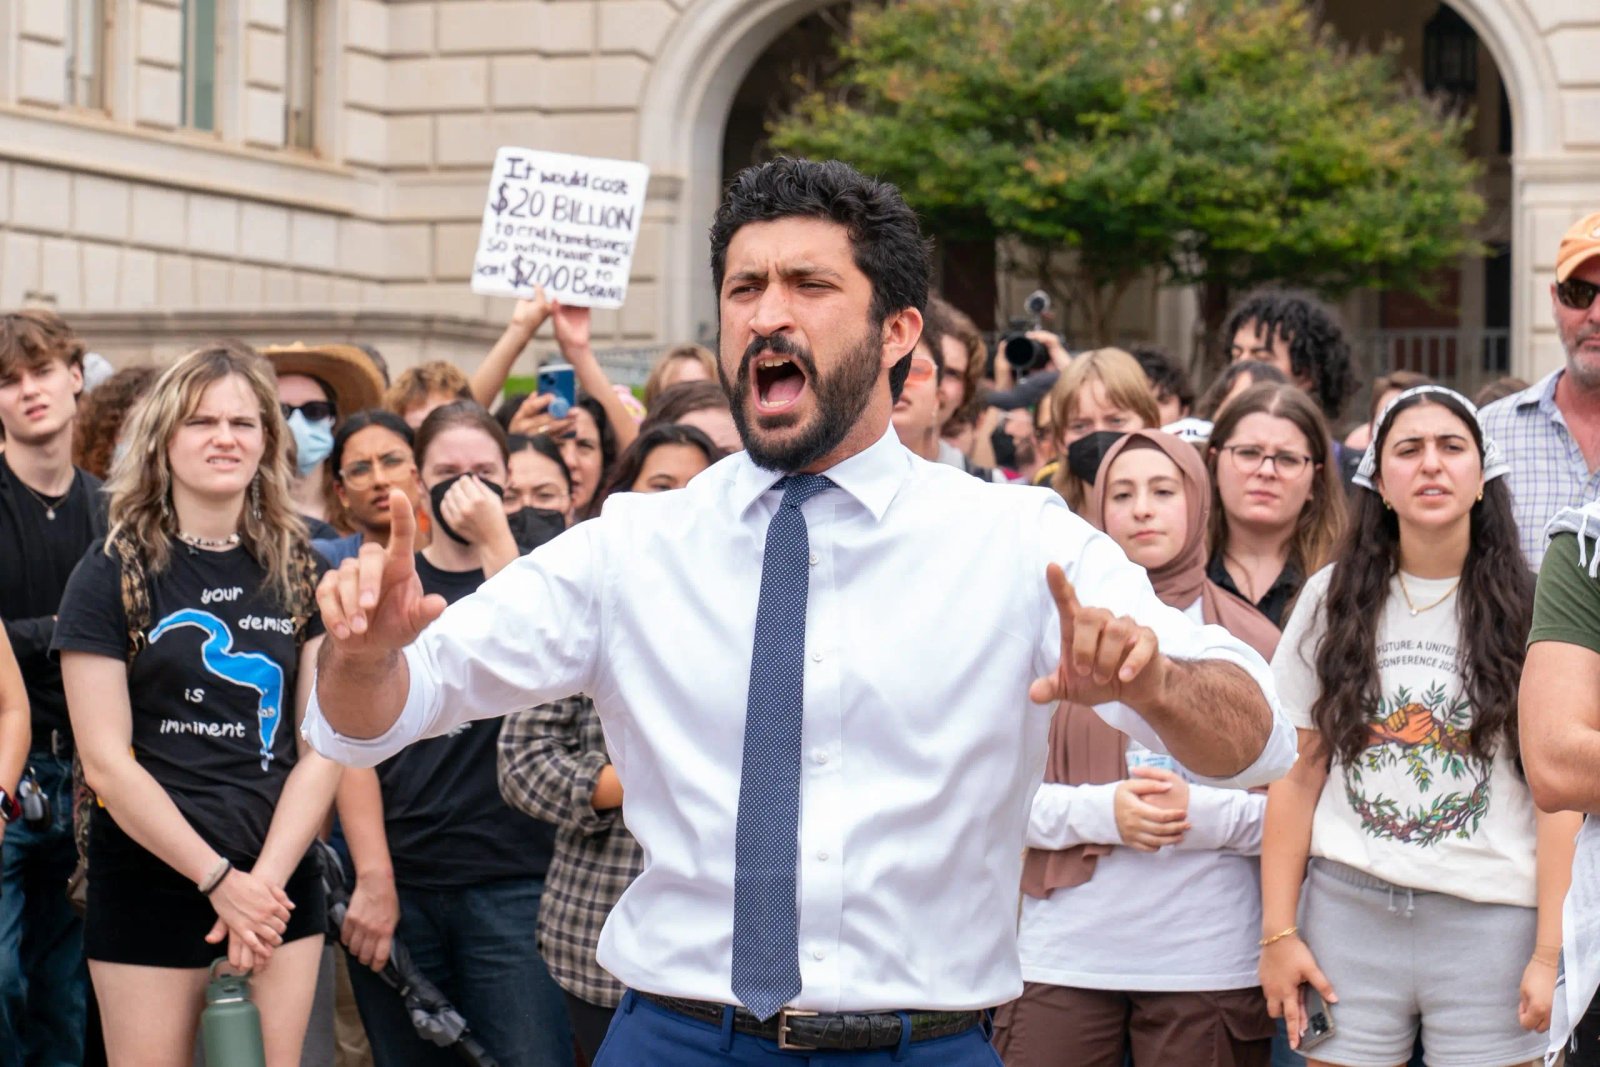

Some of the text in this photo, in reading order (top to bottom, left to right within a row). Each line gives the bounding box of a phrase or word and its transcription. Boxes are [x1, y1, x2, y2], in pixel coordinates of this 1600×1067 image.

[504, 157, 629, 195] It would cost
[491, 182, 635, 231] $20 BILLION
[598, 255, 621, 266] we
[508, 254, 589, 295] $200B
[201, 586, 244, 605] your
[238, 614, 295, 636] demis
[1416, 639, 1424, 650] A
[1425, 640, 1457, 656] UNITED
[1377, 655, 1437, 670] CONFERENCE
[184, 688, 206, 703] is
